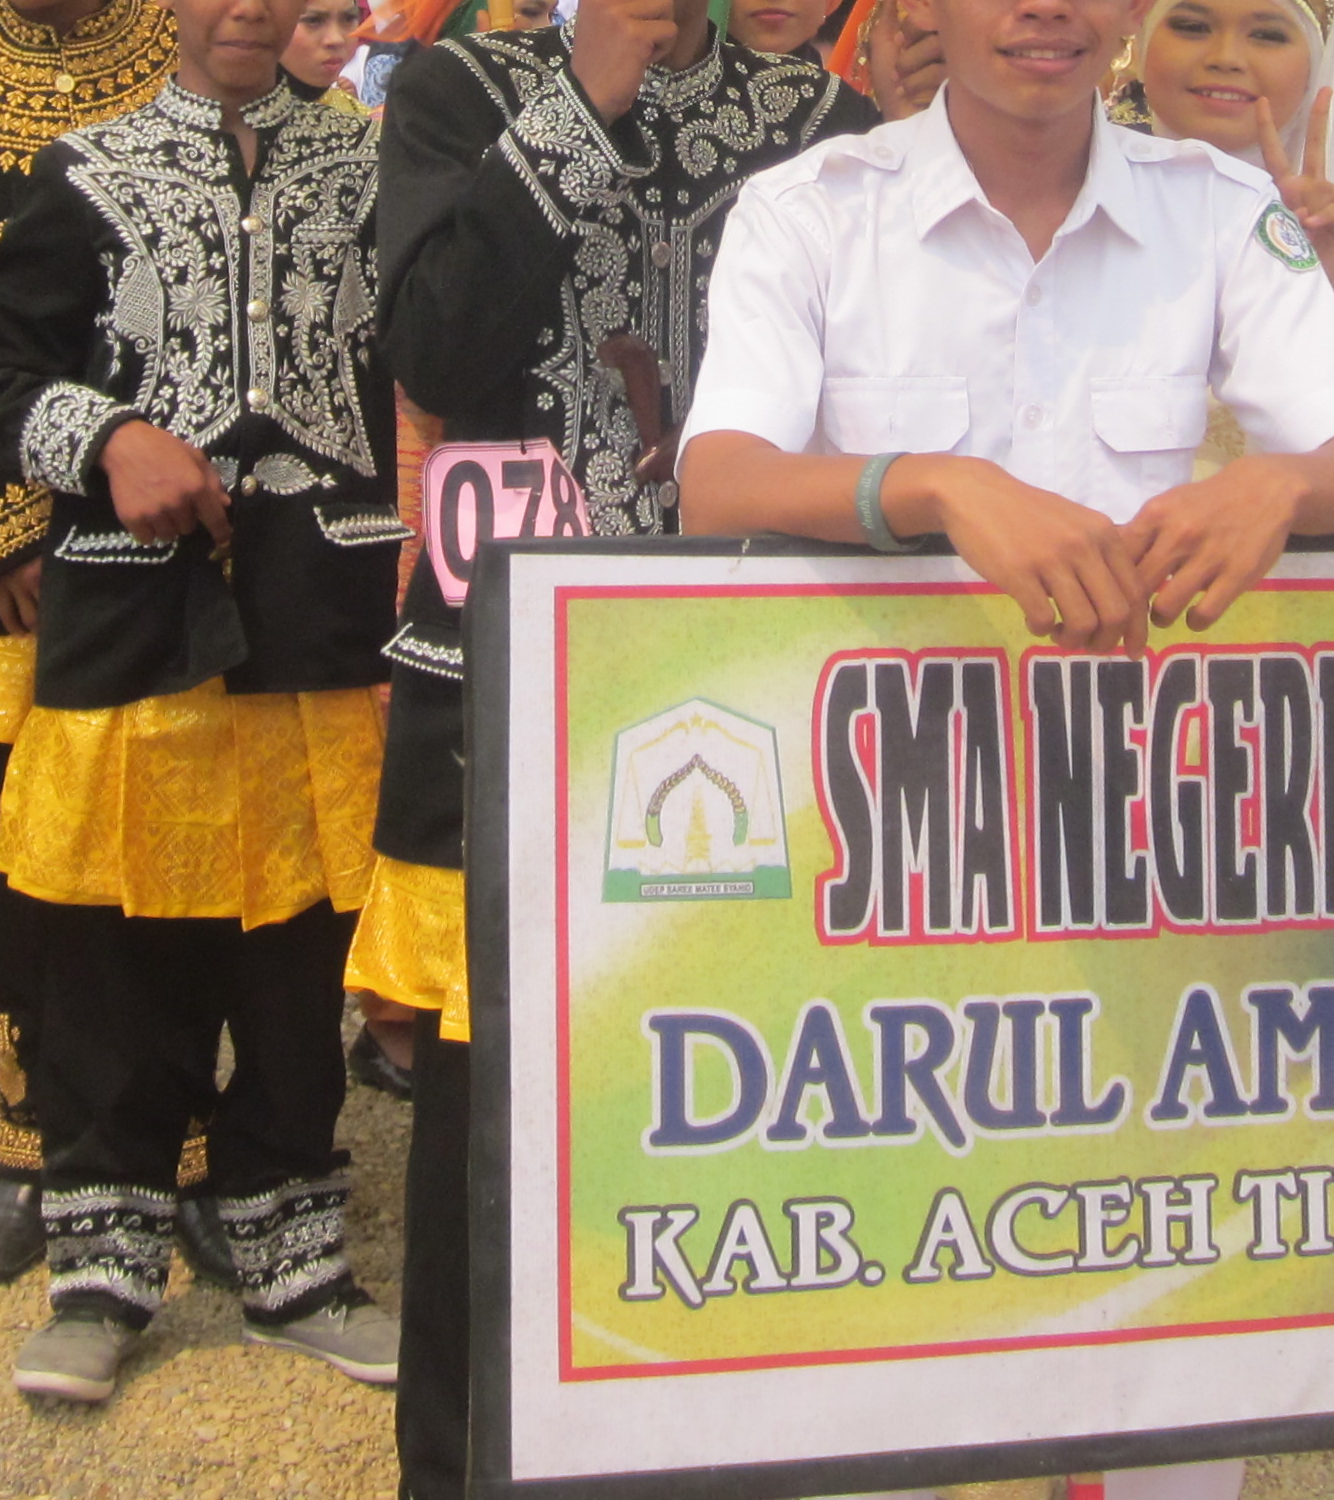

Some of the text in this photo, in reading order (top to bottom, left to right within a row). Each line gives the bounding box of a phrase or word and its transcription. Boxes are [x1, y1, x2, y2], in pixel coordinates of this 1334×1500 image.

[821, 655, 1016, 940] SMA
[646, 996, 1126, 1153] DARUL
[621, 1200, 886, 1307] KAB.
[903, 1186, 1220, 1285] ACEH
